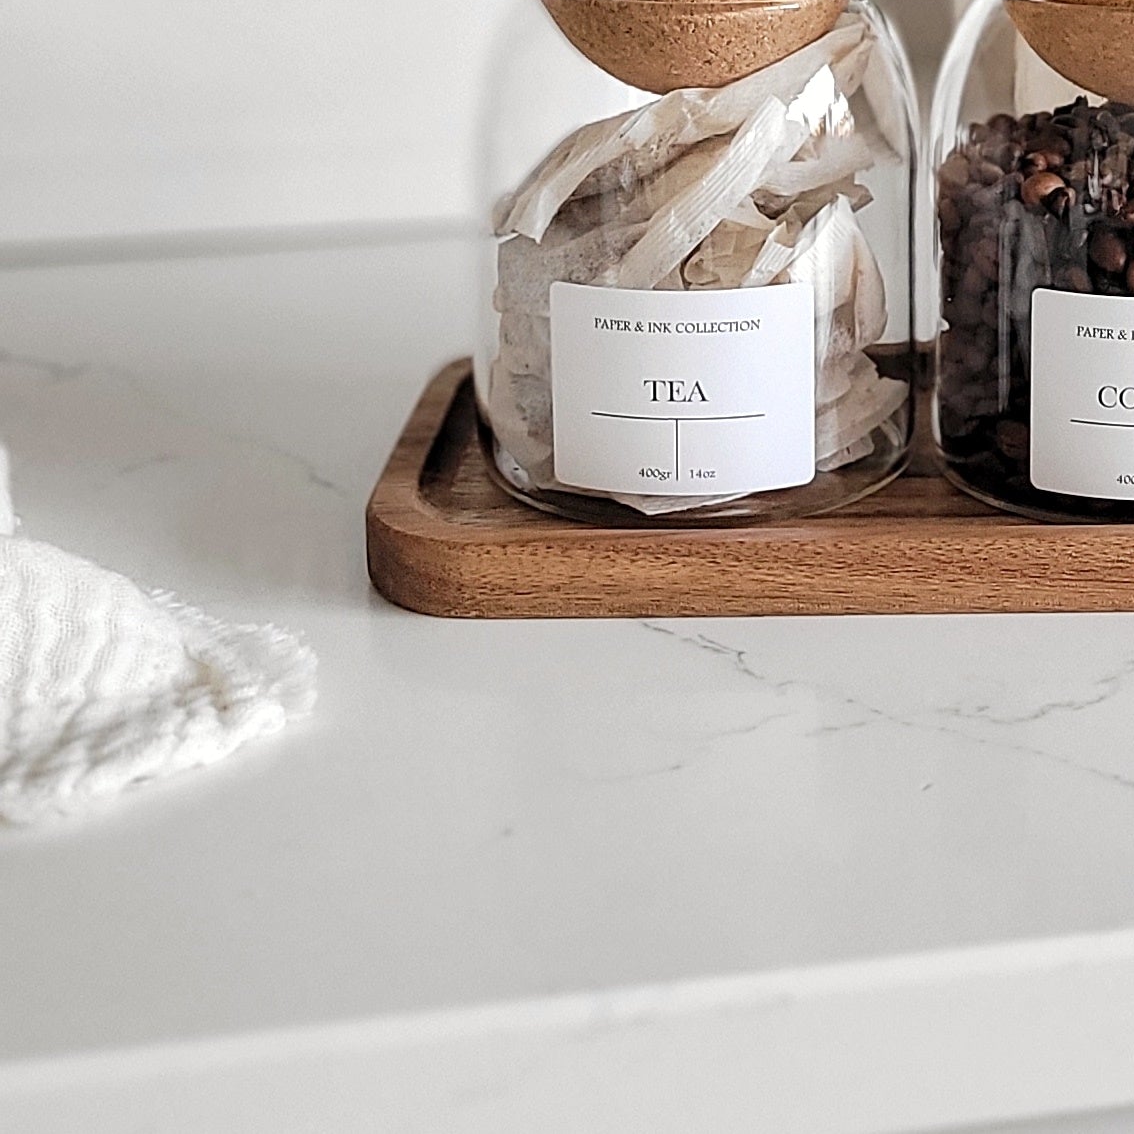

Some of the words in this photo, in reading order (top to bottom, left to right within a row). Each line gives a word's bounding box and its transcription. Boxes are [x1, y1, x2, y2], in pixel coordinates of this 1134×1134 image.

[594, 317, 631, 332] PAPER
[634, 321, 645, 332] &
[647, 322, 672, 334] INK
[675, 319, 761, 334] COLLECTION
[1076, 326, 1114, 340] PAPER
[1117, 329, 1128, 341] &
[643, 379, 710, 403] TEA
[638, 468, 672, 481] 400gr
[689, 469, 716, 479] 14oz
